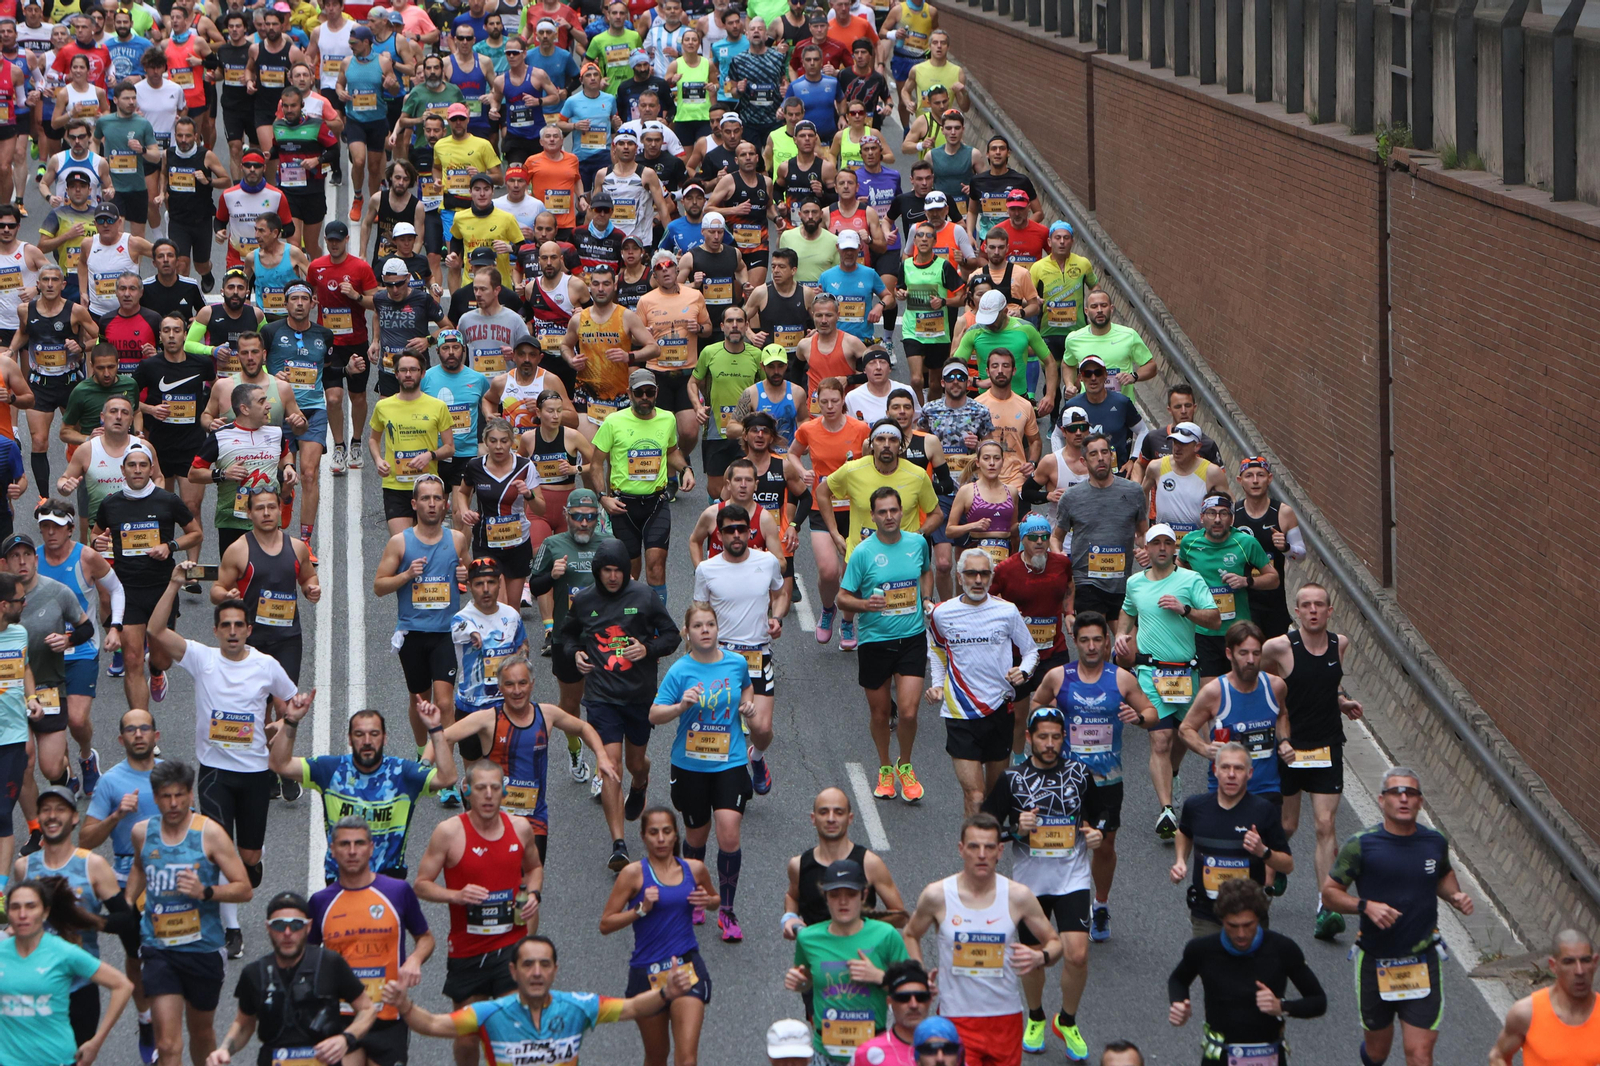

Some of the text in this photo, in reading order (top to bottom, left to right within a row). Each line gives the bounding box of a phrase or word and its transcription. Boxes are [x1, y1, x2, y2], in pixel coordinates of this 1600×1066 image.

[490, 325, 511, 345] TECH
[947, 637, 987, 645] MARATÓN
[165, 904, 190, 912] ZURICH
[1247, 1047, 1274, 1056] ZURICH
